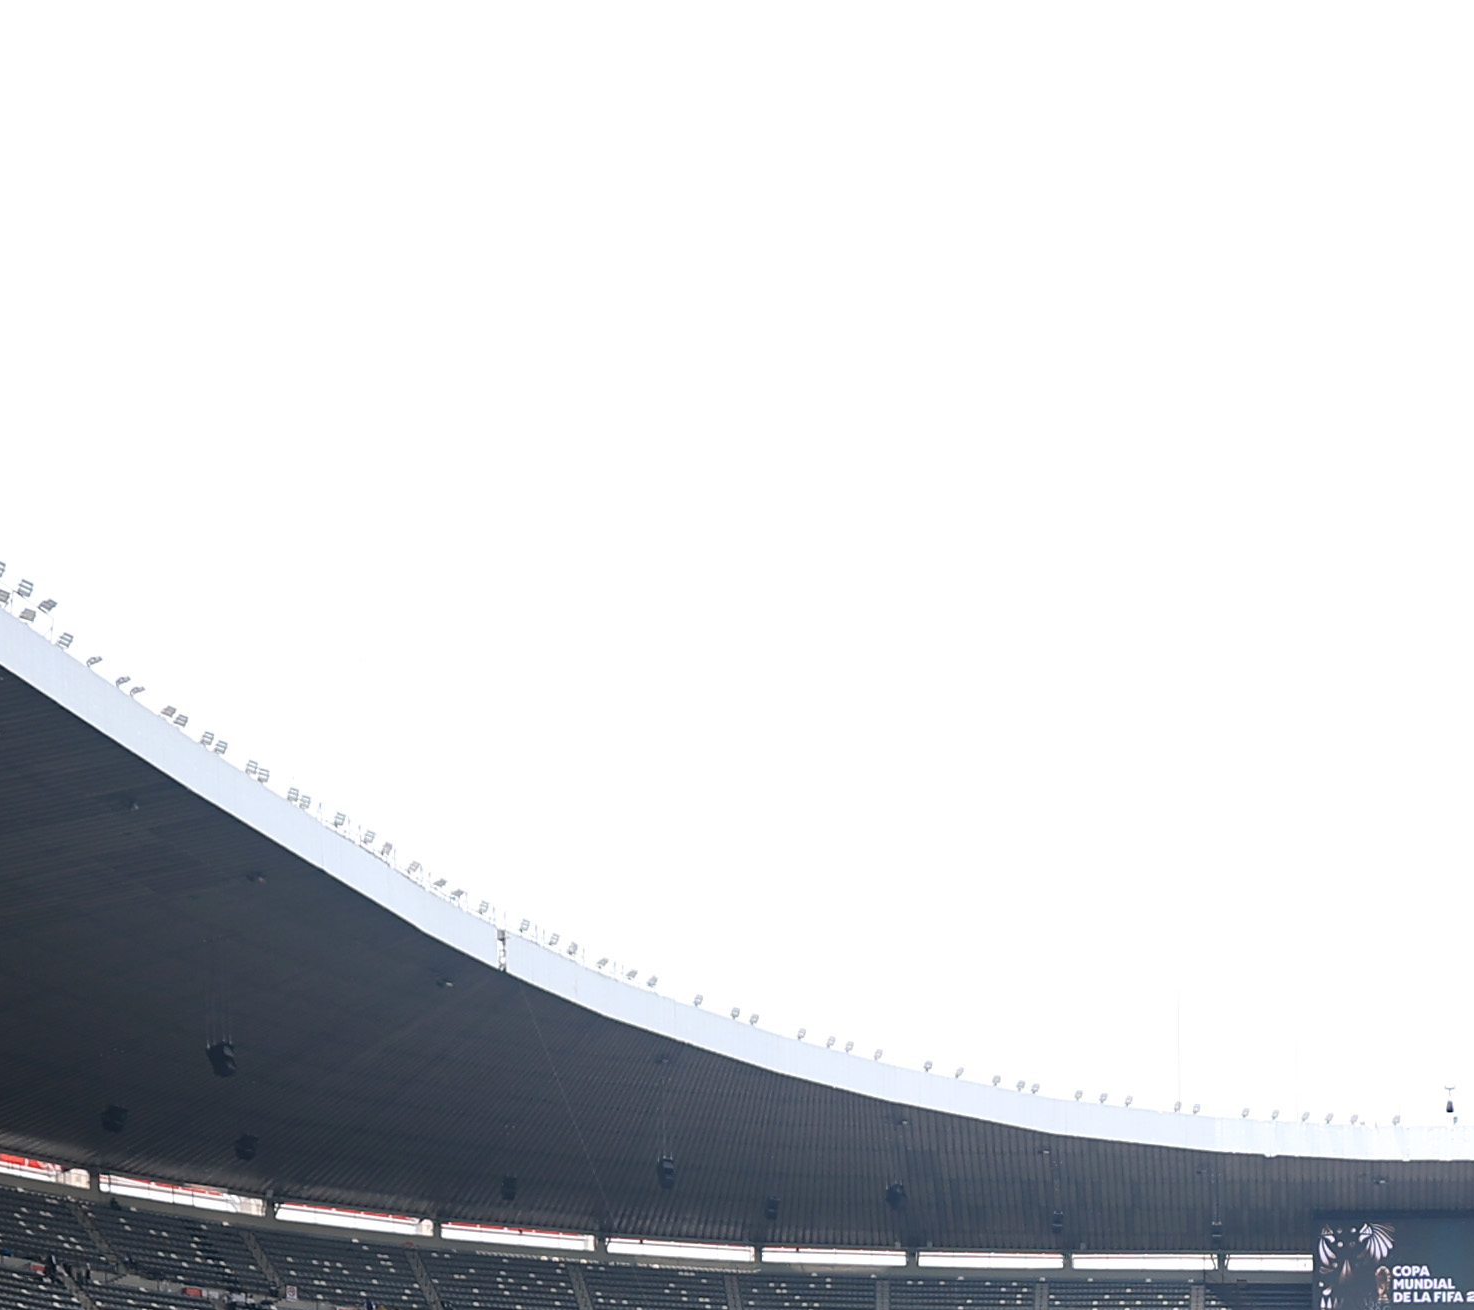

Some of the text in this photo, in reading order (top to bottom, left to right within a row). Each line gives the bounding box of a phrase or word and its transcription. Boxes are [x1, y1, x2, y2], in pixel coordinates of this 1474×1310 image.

[1392, 1265, 1430, 1277] COPA
[1392, 1278, 1455, 1290] MUNDIAL
[1392, 1291, 1411, 1303] DE
[1413, 1291, 1432, 1303] LA
[1434, 1291, 1464, 1303] FIFA
